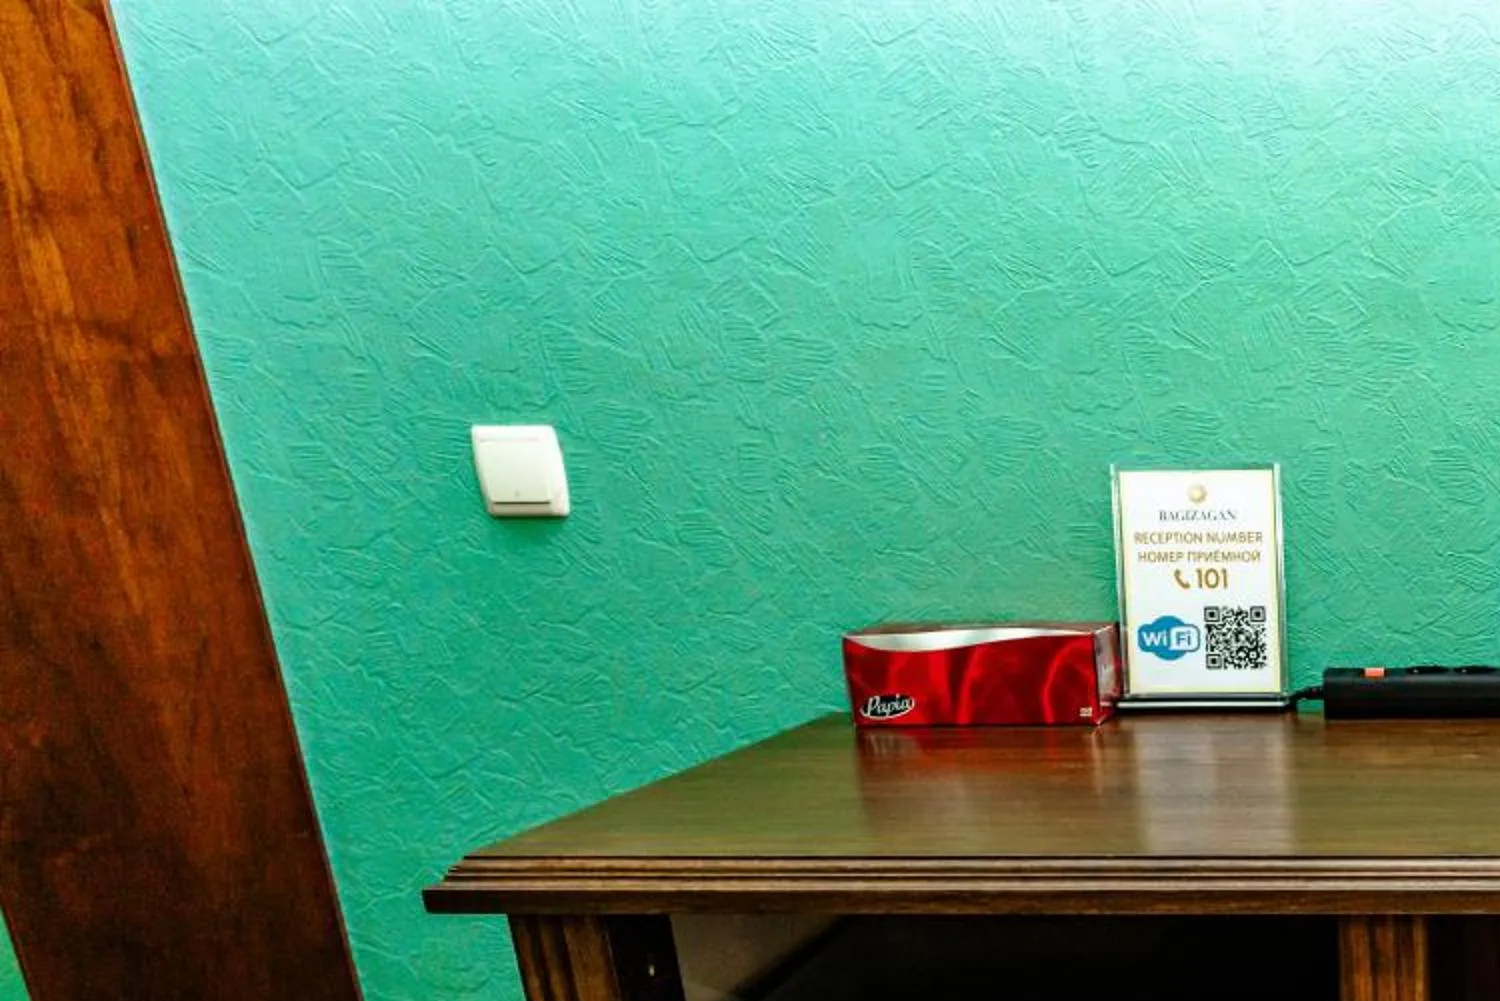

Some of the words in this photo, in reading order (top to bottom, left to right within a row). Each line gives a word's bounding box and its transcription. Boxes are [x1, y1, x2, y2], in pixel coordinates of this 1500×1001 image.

[1158, 509, 1236, 521] BAGIZAGAN
[1134, 531, 1202, 545] RECEPTION
[1206, 531, 1263, 544] NUMBER
[1138, 551, 1184, 563] НОМЕР
[1187, 548, 1261, 563] ПРИЁМНОЙ
[1195, 567, 1228, 589] 101
[866, 694, 911, 717] Papia
